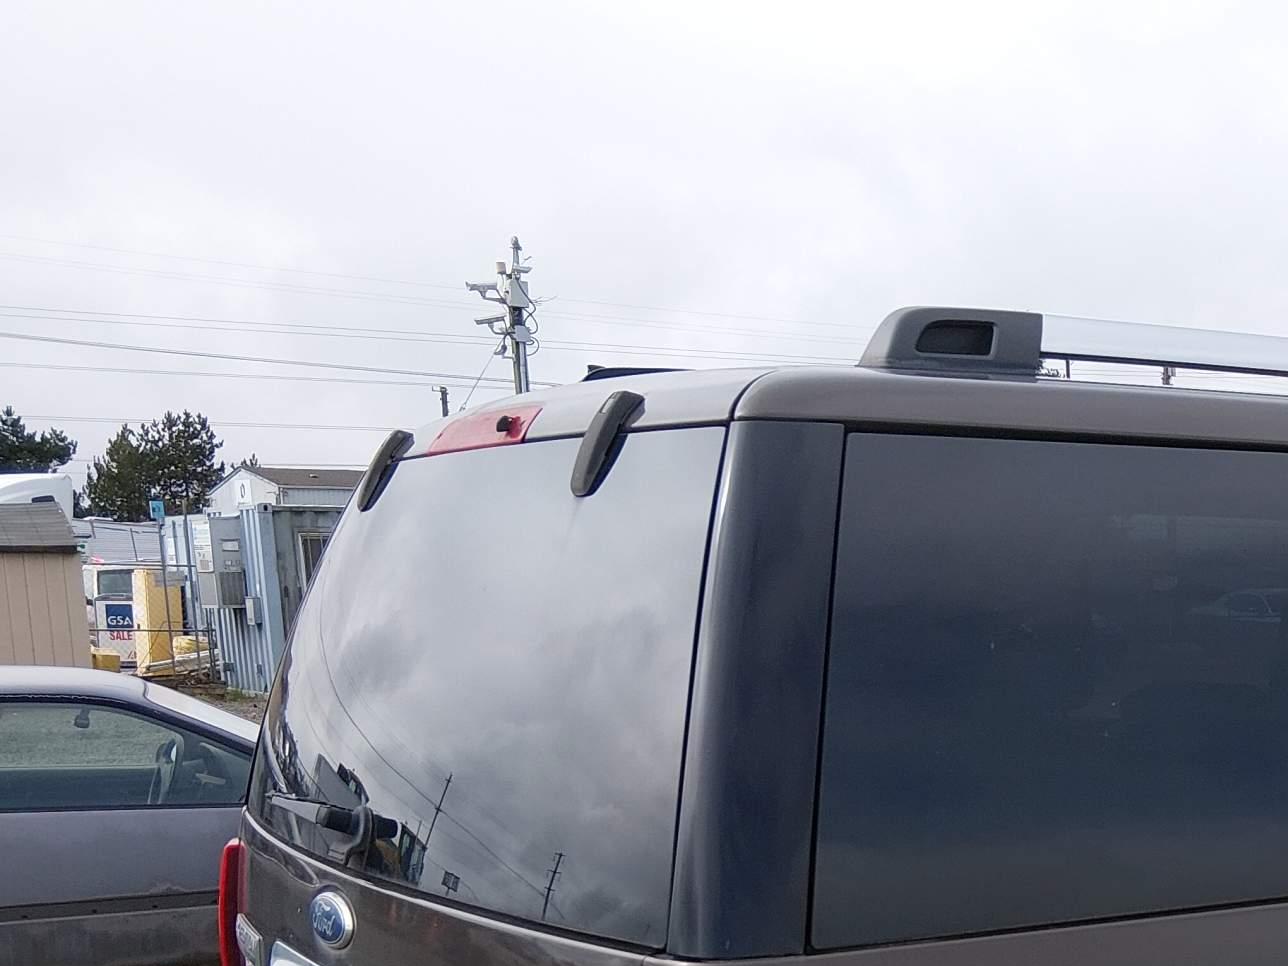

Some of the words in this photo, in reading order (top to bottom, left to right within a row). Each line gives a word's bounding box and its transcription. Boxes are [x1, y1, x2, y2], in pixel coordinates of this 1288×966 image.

[107, 615, 133, 626] GSA
[110, 631, 133, 641] SALE
[312, 900, 336, 937] Ford
